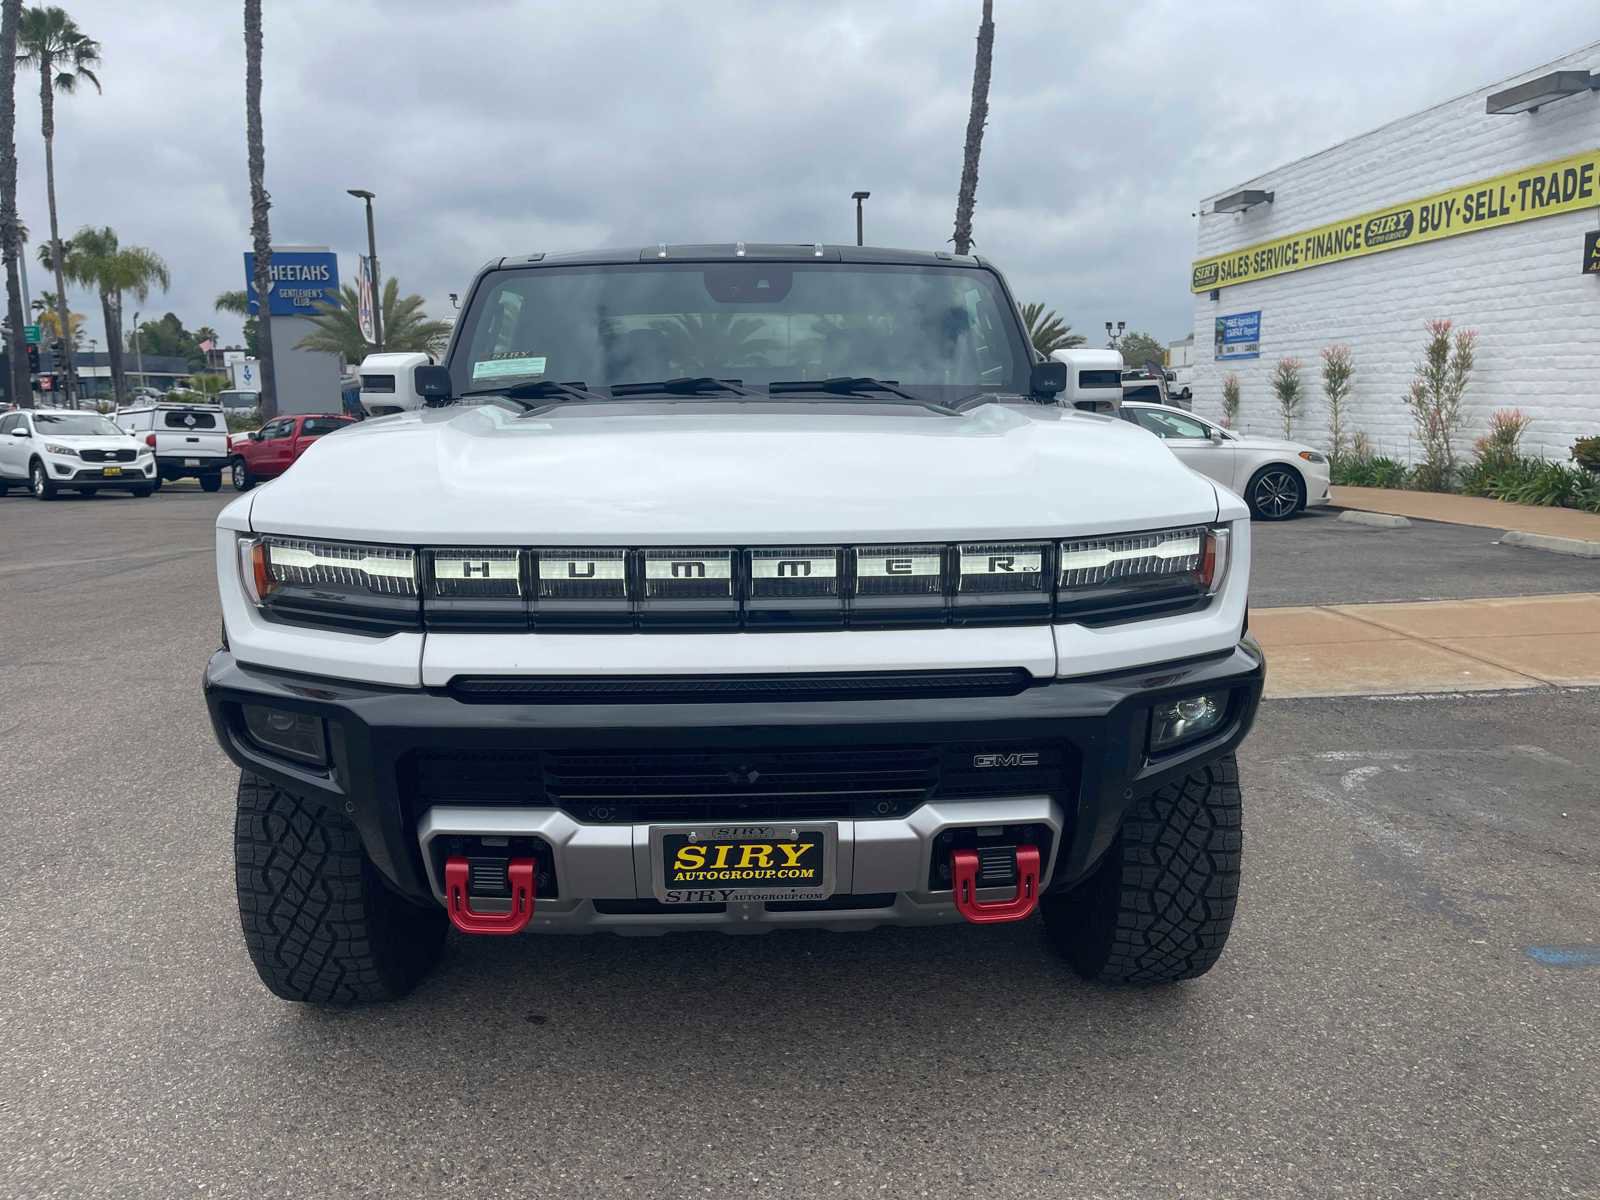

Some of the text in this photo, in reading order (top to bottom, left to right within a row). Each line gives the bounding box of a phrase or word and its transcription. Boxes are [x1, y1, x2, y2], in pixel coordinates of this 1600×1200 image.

[1419, 163, 1594, 234] BUY SELL TRADE
[1368, 212, 1411, 237] SIRY
[1220, 224, 1362, 281] SALES SERVICE FINANCE
[268, 264, 330, 281] HEETAHS
[973, 753, 1039, 768] GMC
[673, 843, 814, 870] SIRY
[673, 869, 814, 881] AUTOGROUP.COM
[665, 889, 735, 903] SIRY
